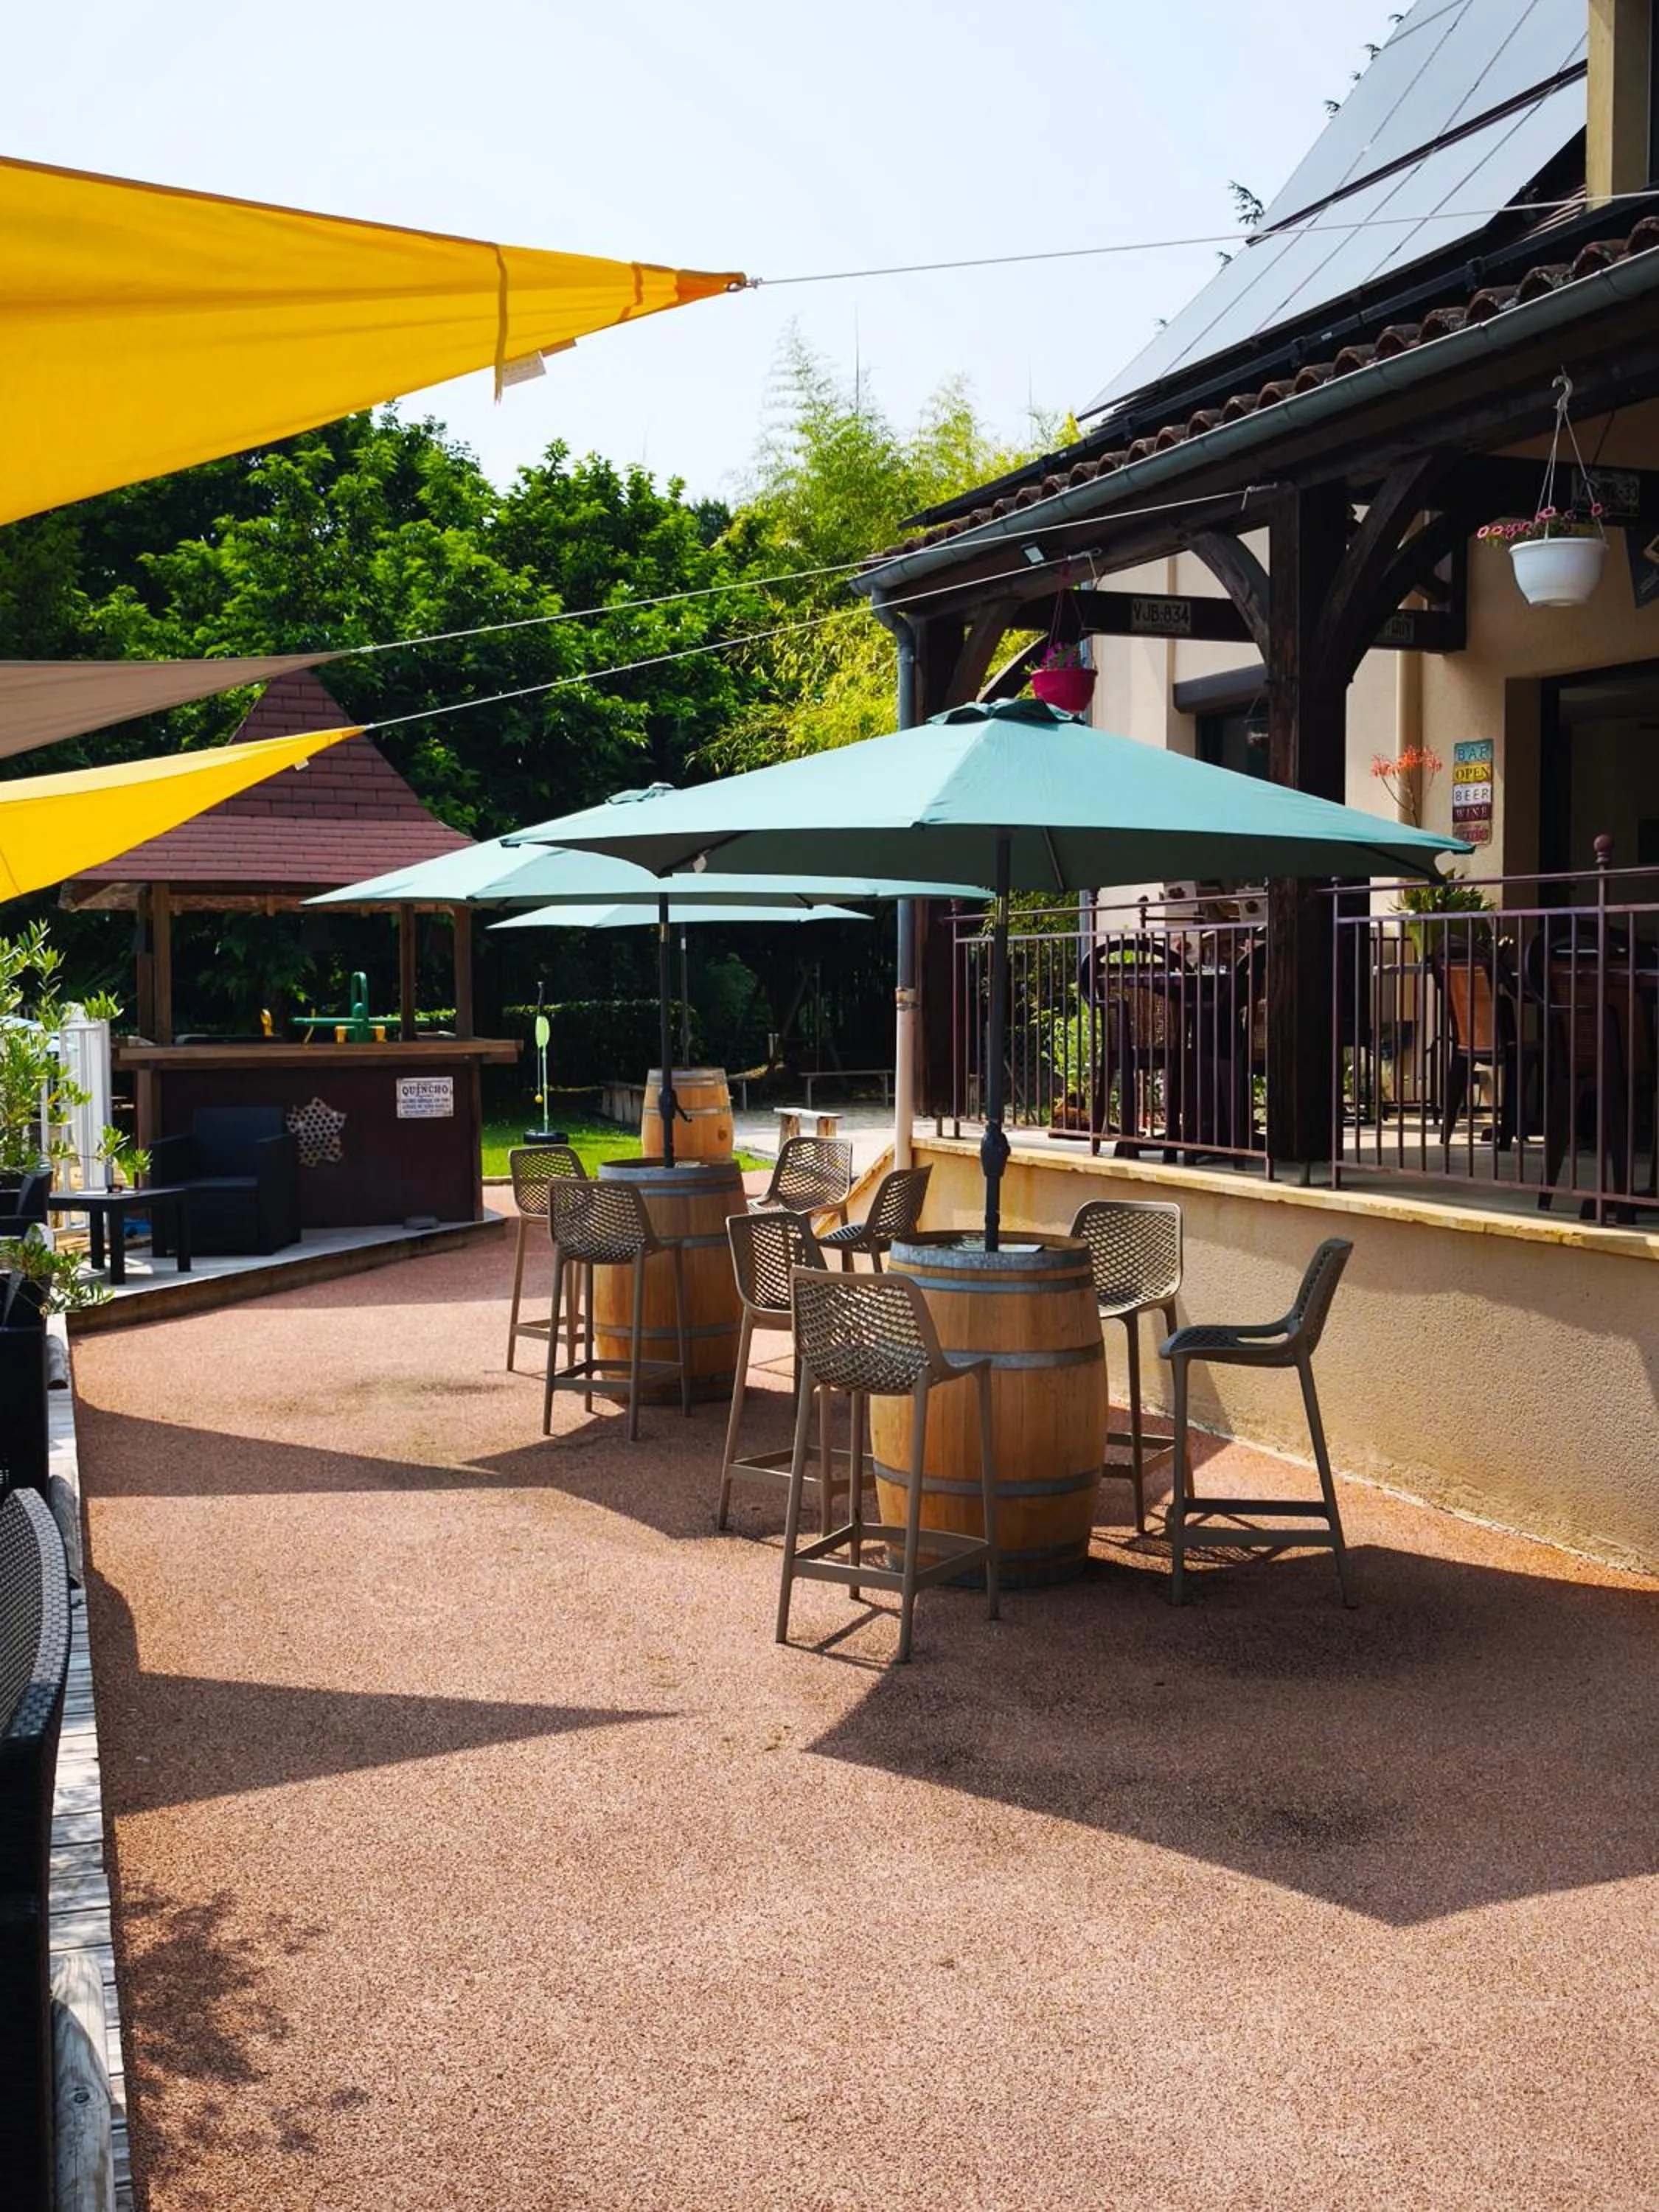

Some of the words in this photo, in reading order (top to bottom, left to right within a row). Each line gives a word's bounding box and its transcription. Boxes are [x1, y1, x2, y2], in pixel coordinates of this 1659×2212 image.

[1457, 745, 1489, 762] BAR
[1455, 765, 1489, 780] OPEN
[1455, 789, 1489, 801] BEER
[1455, 807, 1487, 818] WINE
[402, 1083, 448, 1096] QUINCHO
